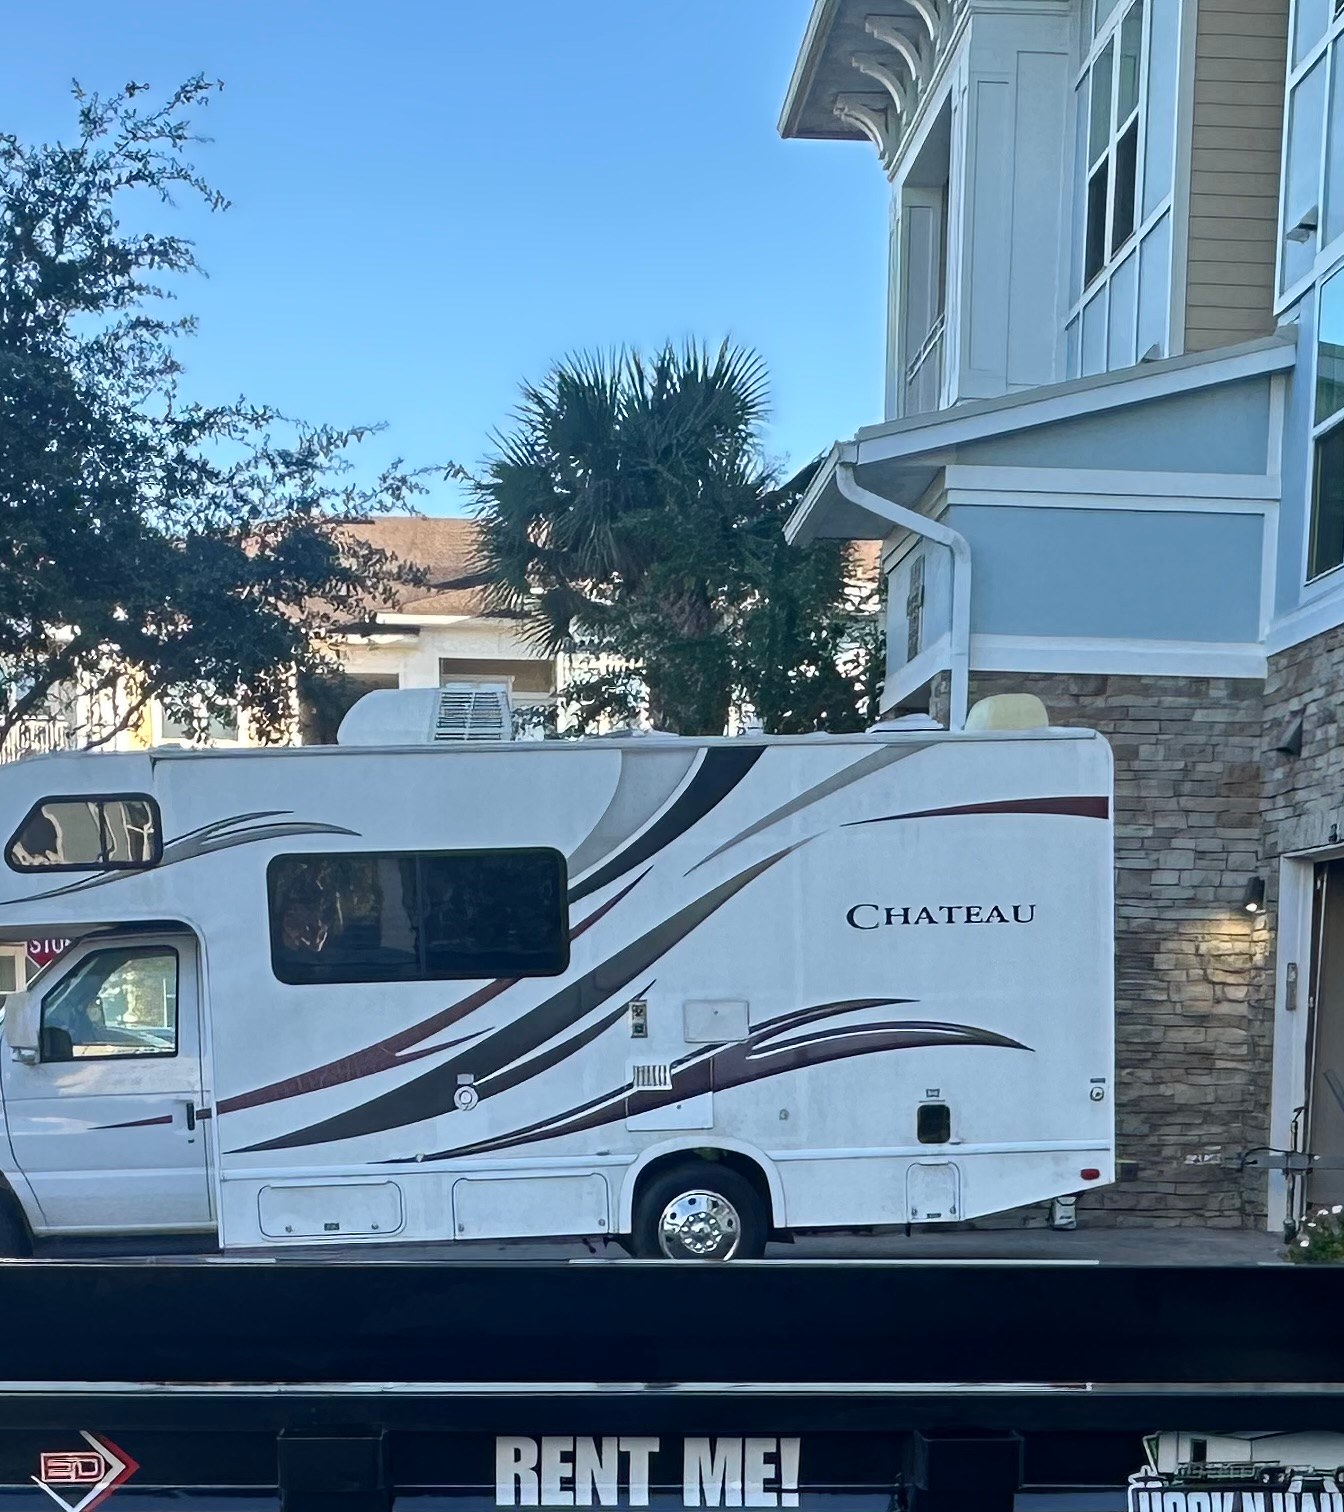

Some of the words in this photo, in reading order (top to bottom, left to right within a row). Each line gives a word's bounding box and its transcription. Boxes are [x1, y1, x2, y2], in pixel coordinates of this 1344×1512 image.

[846, 903, 1037, 930] CHATEAU
[29, 938, 72, 954] STO
[495, 1436, 660, 1506] RENT
[683, 1437, 801, 1507] ME!
